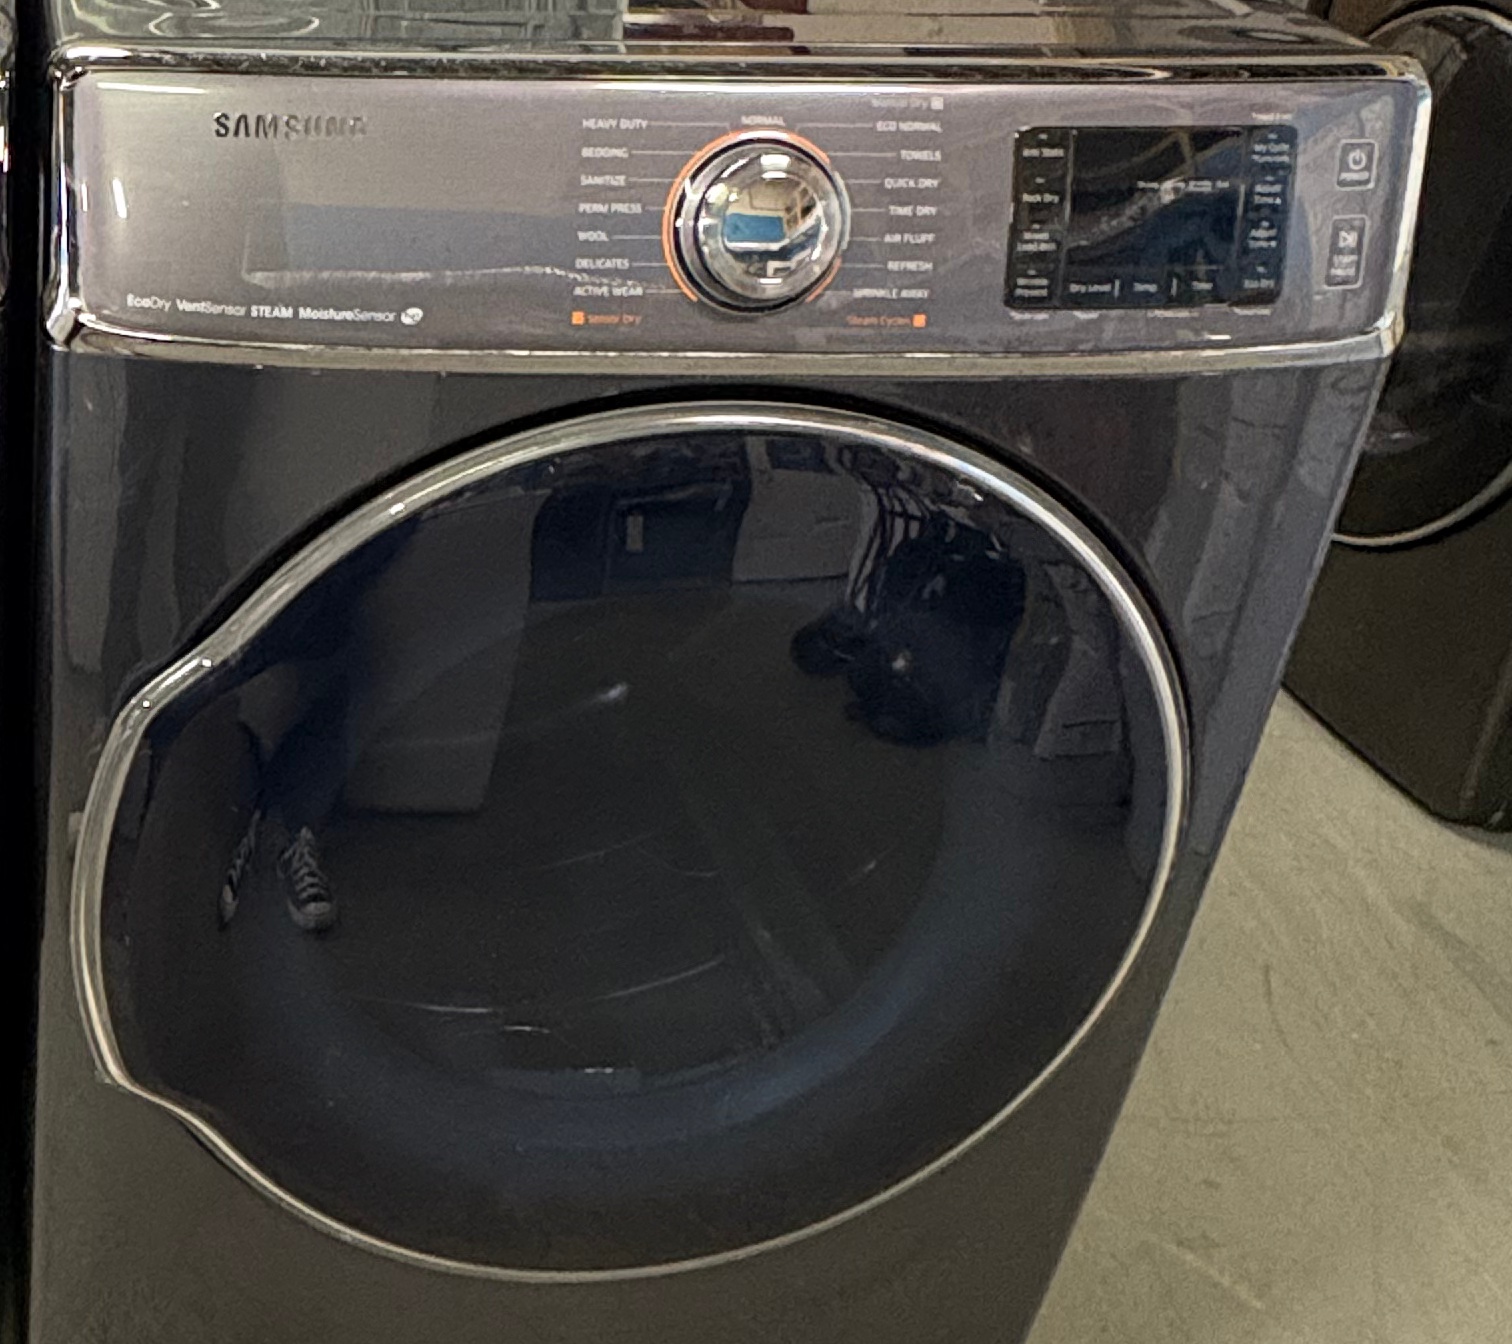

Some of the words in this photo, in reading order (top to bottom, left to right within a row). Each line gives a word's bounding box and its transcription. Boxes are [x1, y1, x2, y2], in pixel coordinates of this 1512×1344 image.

[582, 118, 618, 129] HEAVY
[619, 118, 648, 129] DUTY
[884, 179, 916, 190] QUICK
[918, 179, 940, 189] DRY
[916, 205, 937, 216] DRY
[577, 230, 610, 242] WOOL
[884, 233, 901, 244] AIR
[575, 258, 630, 270] DELICATES
[573, 285, 610, 297] ACTIVE
[611, 286, 644, 297] WEAR
[126, 293, 171, 312] EcoDry
[175, 298, 247, 316] VentSensor
[250, 304, 294, 318] STEAM
[298, 306, 397, 322] MoistureSensor
